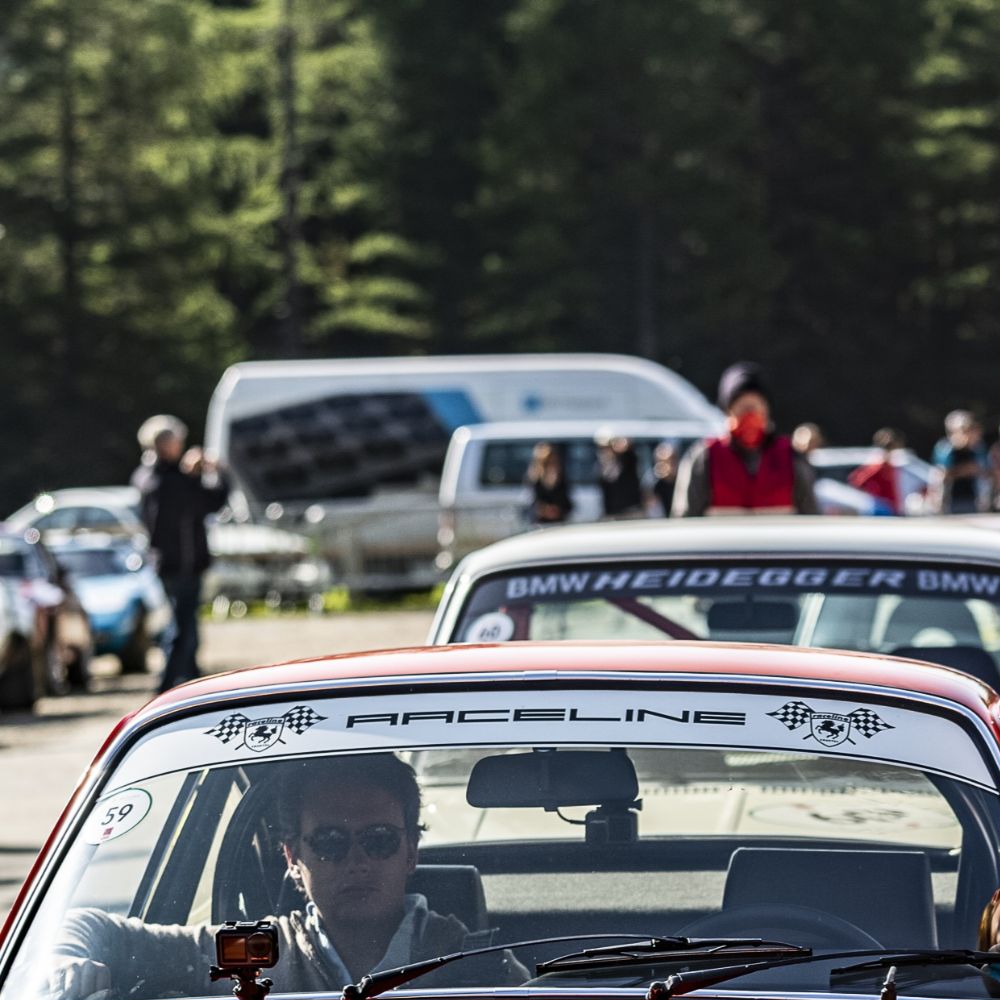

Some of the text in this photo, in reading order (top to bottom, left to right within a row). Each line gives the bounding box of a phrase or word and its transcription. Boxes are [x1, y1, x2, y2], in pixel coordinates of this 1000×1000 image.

[506, 567, 1000, 599] BMW HEIDEGGER BMW
[101, 803, 133, 826] 59
